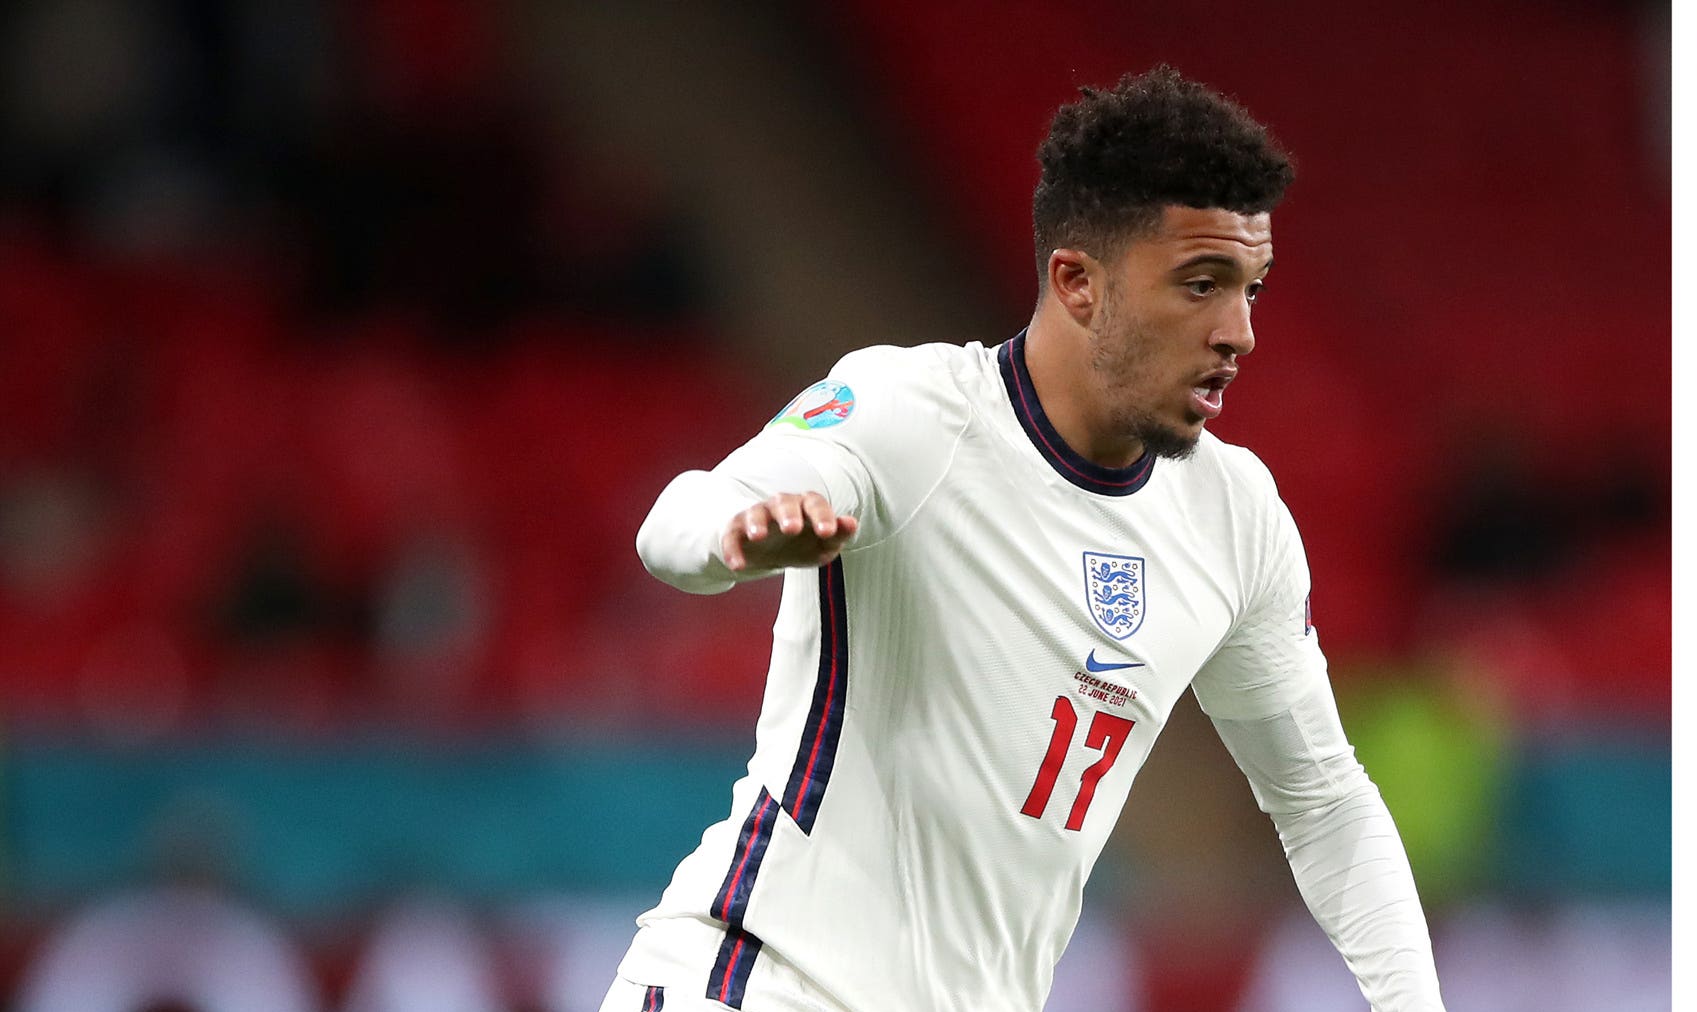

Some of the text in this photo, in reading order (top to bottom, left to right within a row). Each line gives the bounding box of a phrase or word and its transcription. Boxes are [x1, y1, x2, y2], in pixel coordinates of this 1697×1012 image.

[1074, 671, 1138, 699] CZECH REPUBLIC
[1078, 684, 1127, 707] 22 JUNE 2021
[1019, 695, 1136, 832] 17
